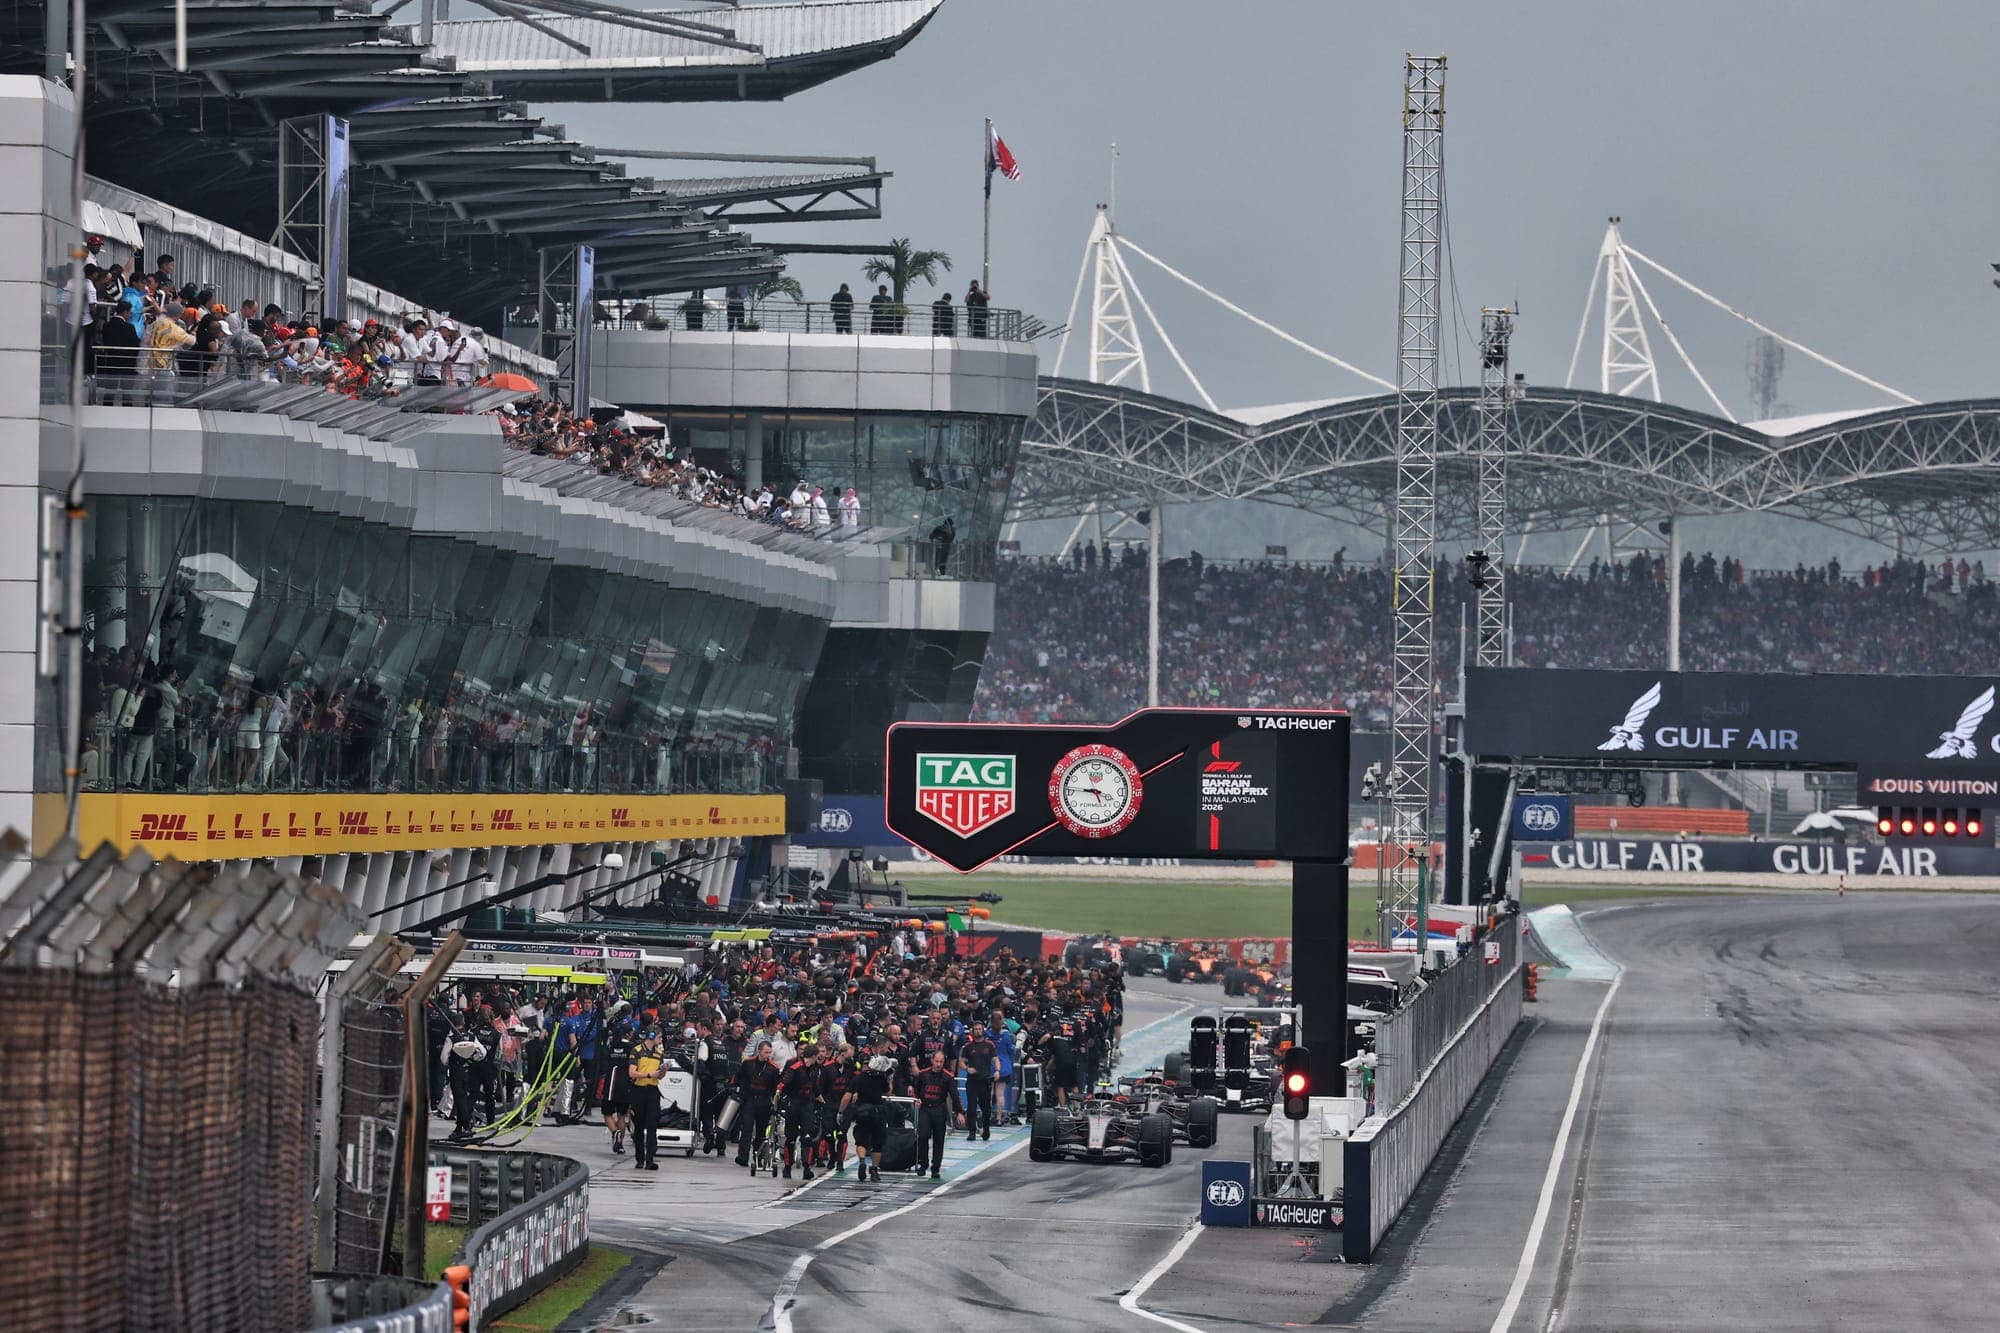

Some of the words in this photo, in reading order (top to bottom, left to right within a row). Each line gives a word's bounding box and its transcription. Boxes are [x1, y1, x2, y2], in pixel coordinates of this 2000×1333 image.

[1655, 727, 1740, 749] GULF
[1746, 728, 1799, 750] AIR
[925, 760, 1006, 785] TAG
[1202, 779, 1251, 787] BAHRAIN
[1875, 779, 1923, 793] LOUIS
[1927, 780, 1998, 794] VUITTON
[1202, 787, 1241, 796] GRAND
[1242, 787, 1269, 796] PRIX
[1213, 796, 1257, 804] MALAYSIA
[922, 792, 1009, 831] HEUER
[1525, 810, 1556, 825] FIA
[134, 814, 195, 841] DHL
[821, 813, 850, 828] FIA
[1552, 841, 1637, 870] GULF
[1647, 842, 1704, 872] AIR
[1772, 845, 1867, 875] GULF
[1876, 846, 1938, 877] AIR
[581, 949, 600, 957] BWT
[618, 950, 637, 958] BWT
[1210, 1185, 1240, 1201] FIA
